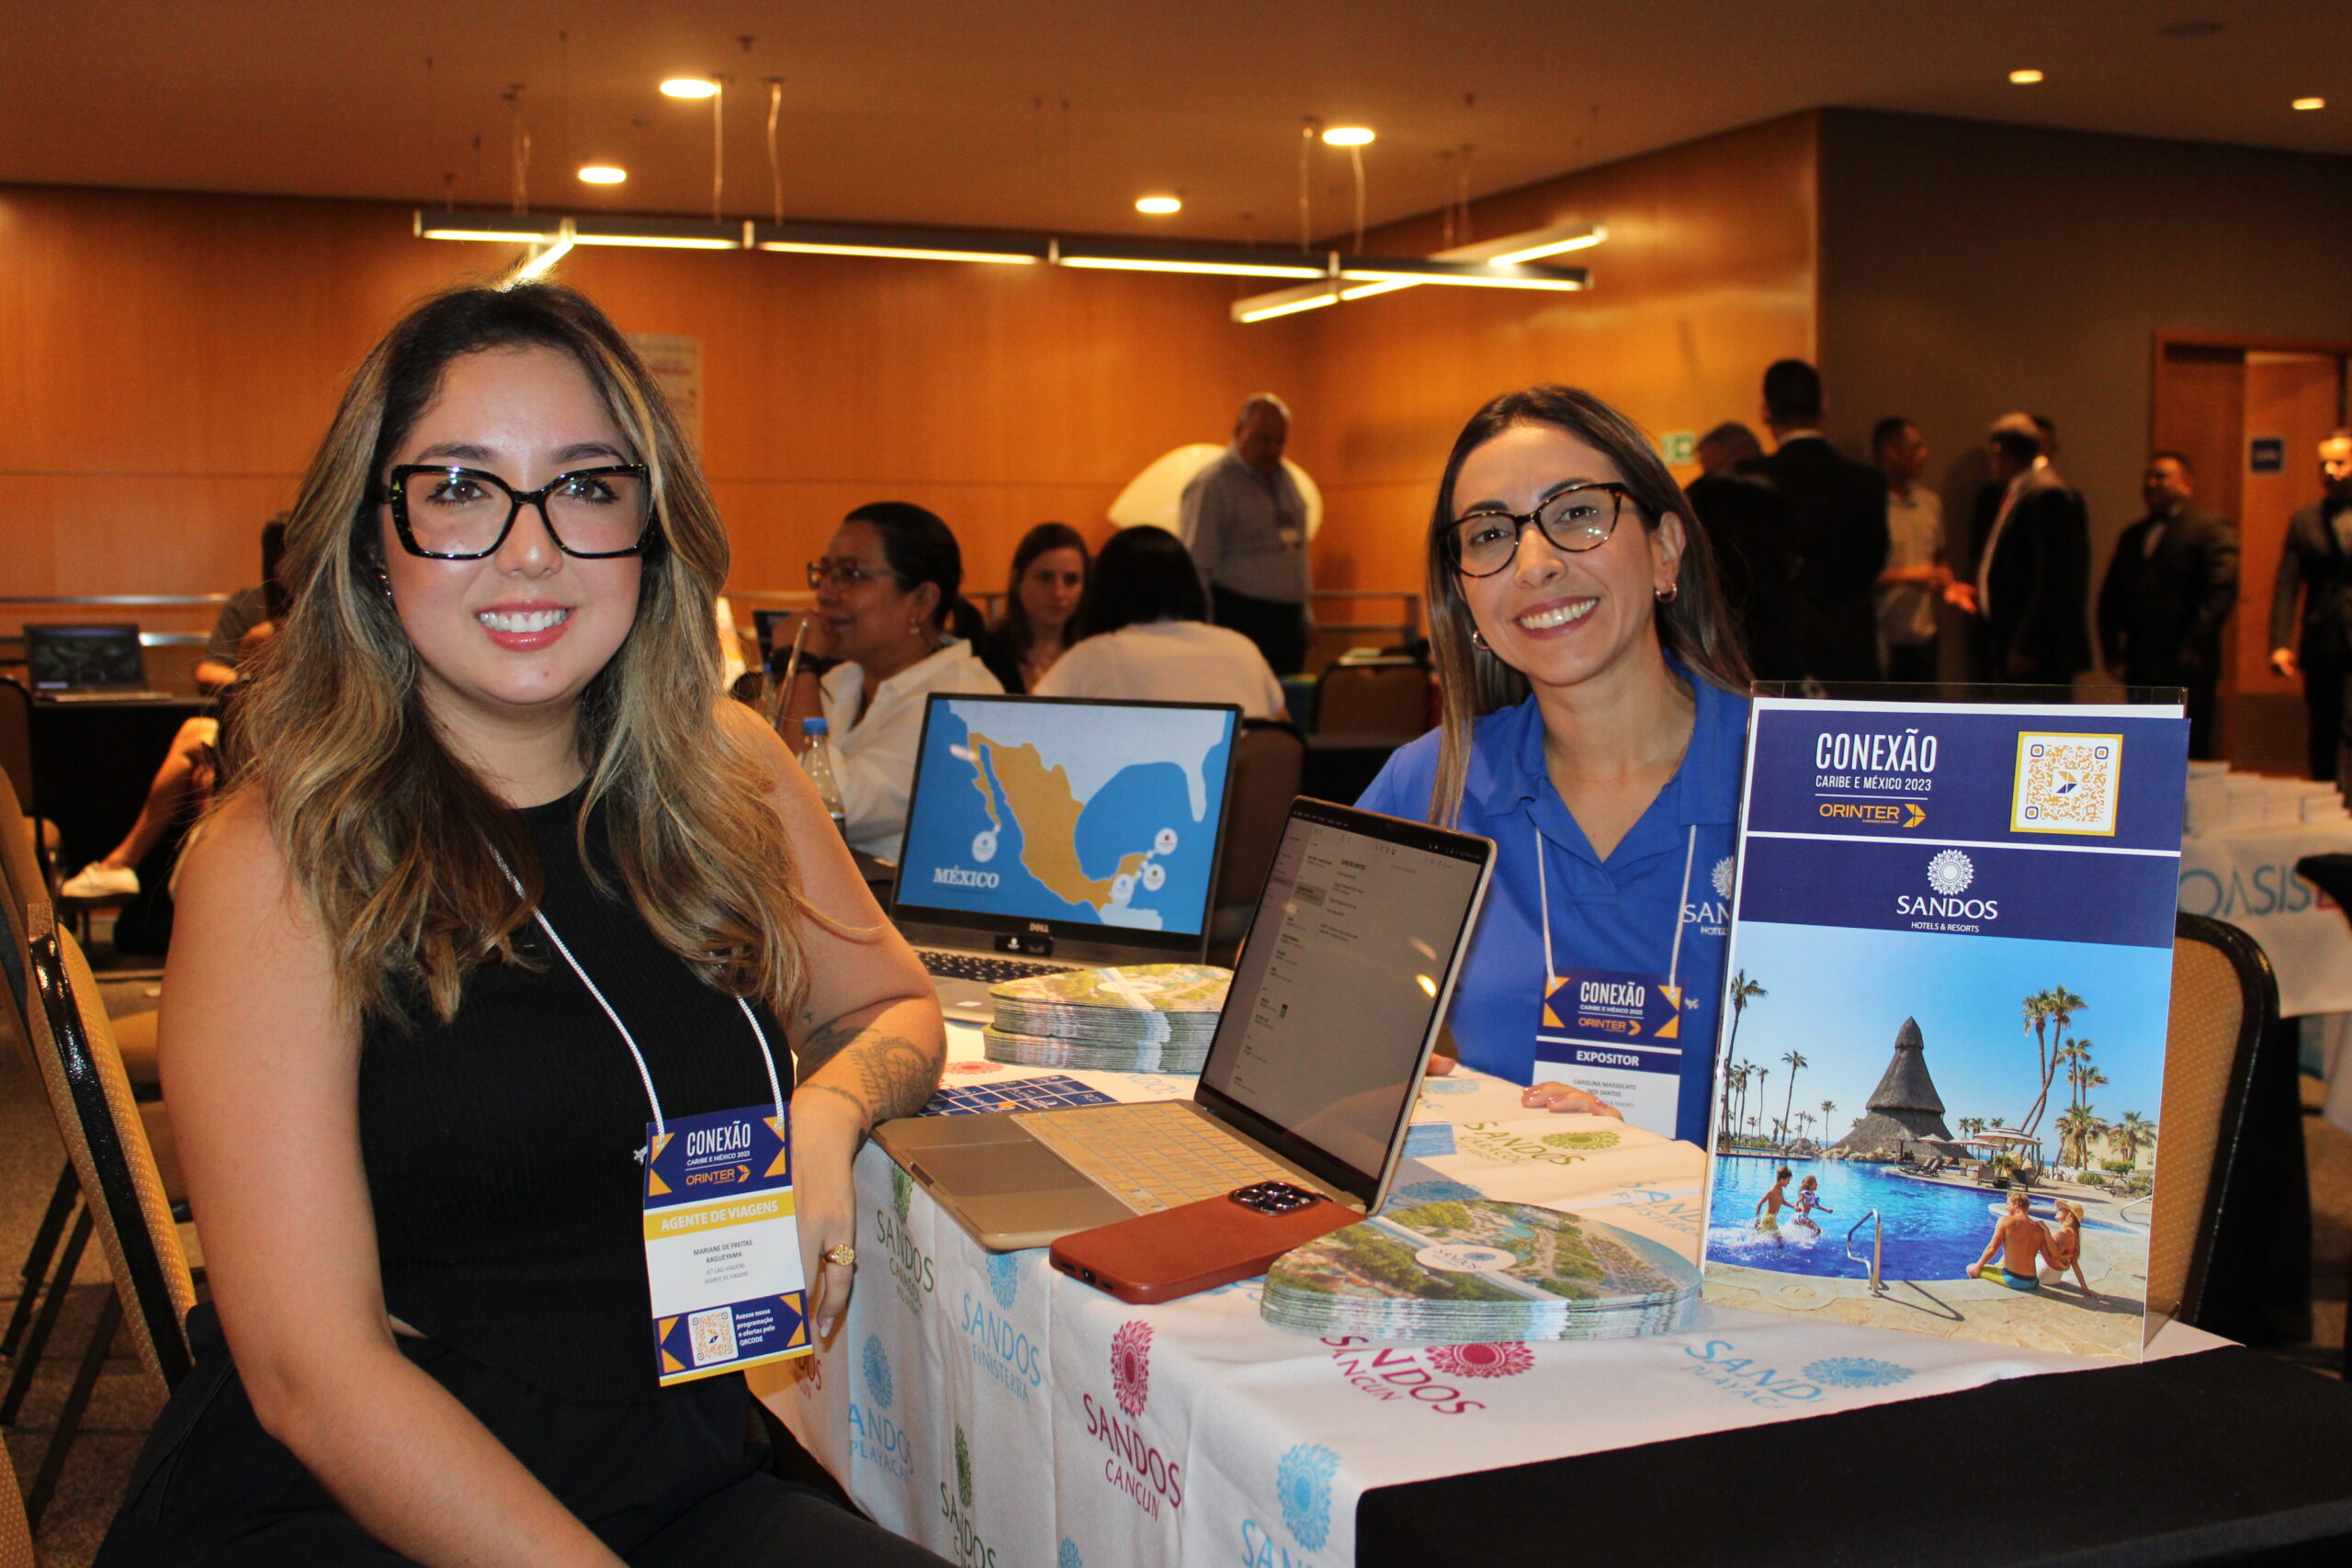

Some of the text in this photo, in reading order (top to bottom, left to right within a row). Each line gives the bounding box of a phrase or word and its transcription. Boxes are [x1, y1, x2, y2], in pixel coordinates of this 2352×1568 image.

[1815, 728, 1938, 773] CONEXÃO
[1815, 774, 1932, 792] CARIBE E MÉXICO 2023
[1819, 803, 1900, 820] ORINTER
[933, 864, 1000, 889] MÉXICO
[1896, 895, 1998, 920] SANDOS
[1029, 922, 1049, 933] DELL
[1911, 921, 1939, 931] HOTELS
[1948, 923, 1979, 933] RESORTS
[1580, 981, 1645, 1008] CONEXÃO
[1580, 1004, 1600, 1012] CARIBE
[1607, 1006, 1629, 1014] MÉXICO
[1578, 1017, 1627, 1030] ORINTER
[1577, 1050, 1639, 1066] EXPOSITOR
[1573, 1078, 1601, 1088] CAROLINA
[686, 1121, 752, 1156] CONEXÃO
[1463, 1121, 1586, 1166] SANDOS
[686, 1156, 707, 1167] CARIBE
[714, 1152, 737, 1161] MÉXICO
[737, 1150, 751, 1158] 2023
[685, 1168, 736, 1186] ORINTER
[661, 1199, 779, 1232] AGENTE DE VIAGENS
[694, 1239, 753, 1256] MARIANE DE FREITAS
[876, 1209, 934, 1292] SANDOS
[706, 1250, 743, 1264] KAGUEYAMA
[736, 1309, 771, 1320] Acesse nossa
[737, 1316, 774, 1330] programação
[743, 1328, 763, 1337] ofertas
[763, 1325, 775, 1334] pelo
[961, 1292, 1041, 1387] SANDOS
[740, 1336, 763, 1347] QRCODE
[1083, 1393, 1182, 1508] SANDOS
[1105, 1458, 1160, 1523] CANCUN
